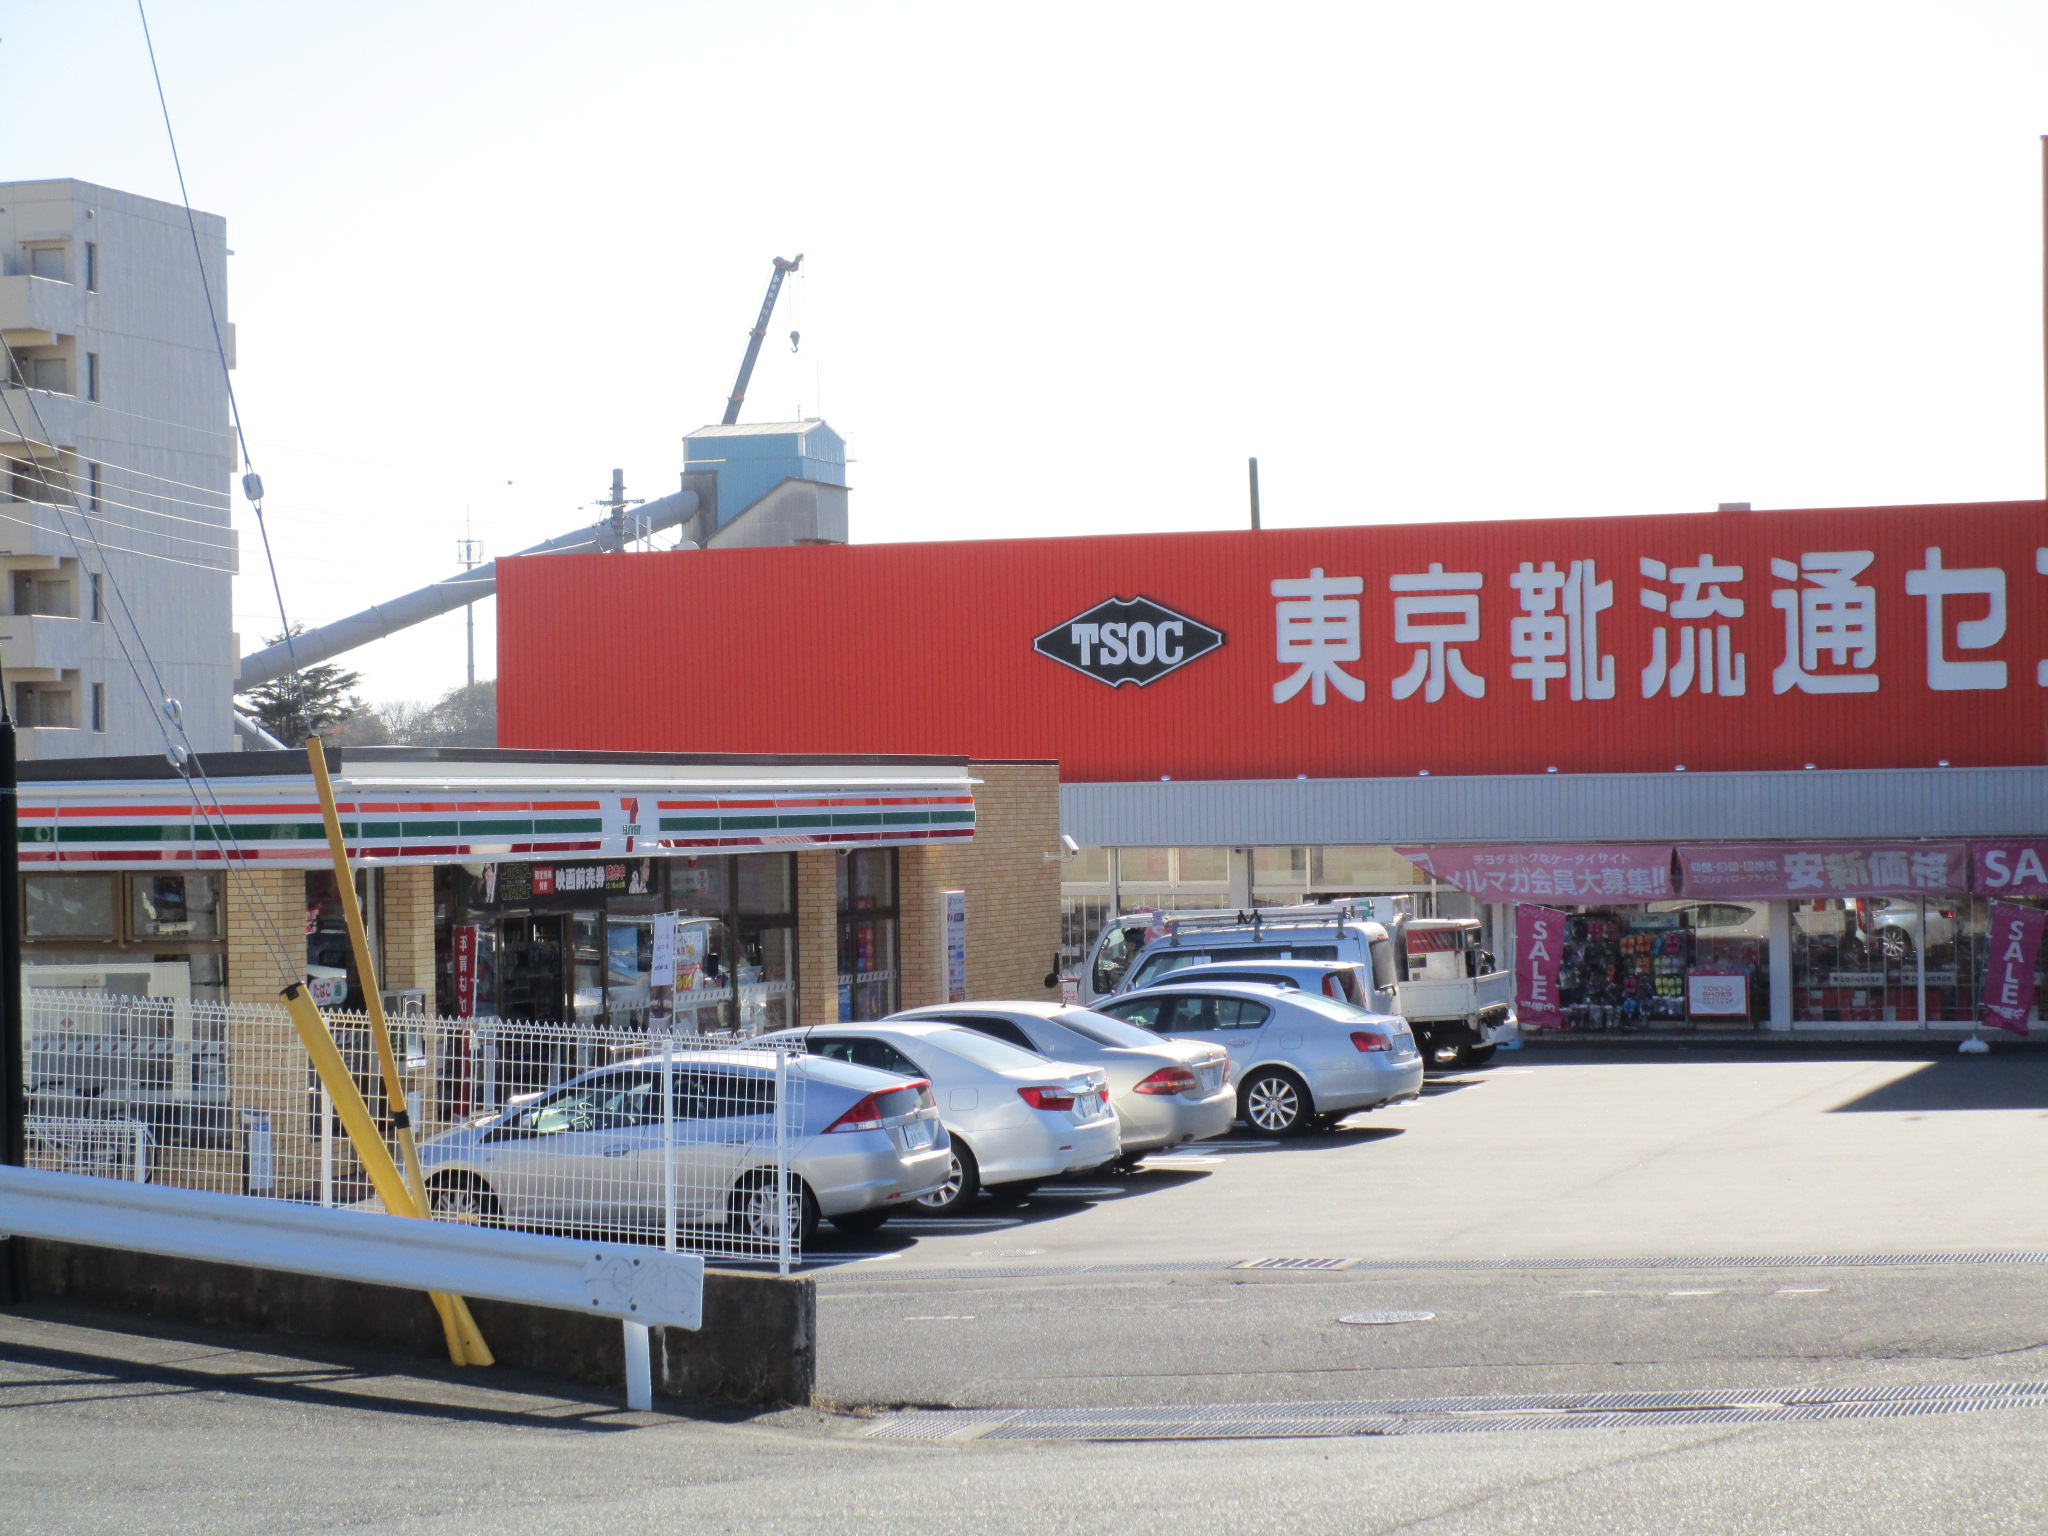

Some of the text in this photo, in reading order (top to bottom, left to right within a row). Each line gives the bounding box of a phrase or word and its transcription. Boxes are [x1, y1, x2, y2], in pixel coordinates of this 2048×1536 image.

[1071, 620, 1184, 666] TSOC
[1271, 546, 2048, 705] 東京靴流通セ
[555, 866, 605, 891] 映画前売券
[313, 981, 332, 998] たばこ
[1528, 920, 1550, 1001] SALE
[2001, 920, 2025, 1005] SALE
